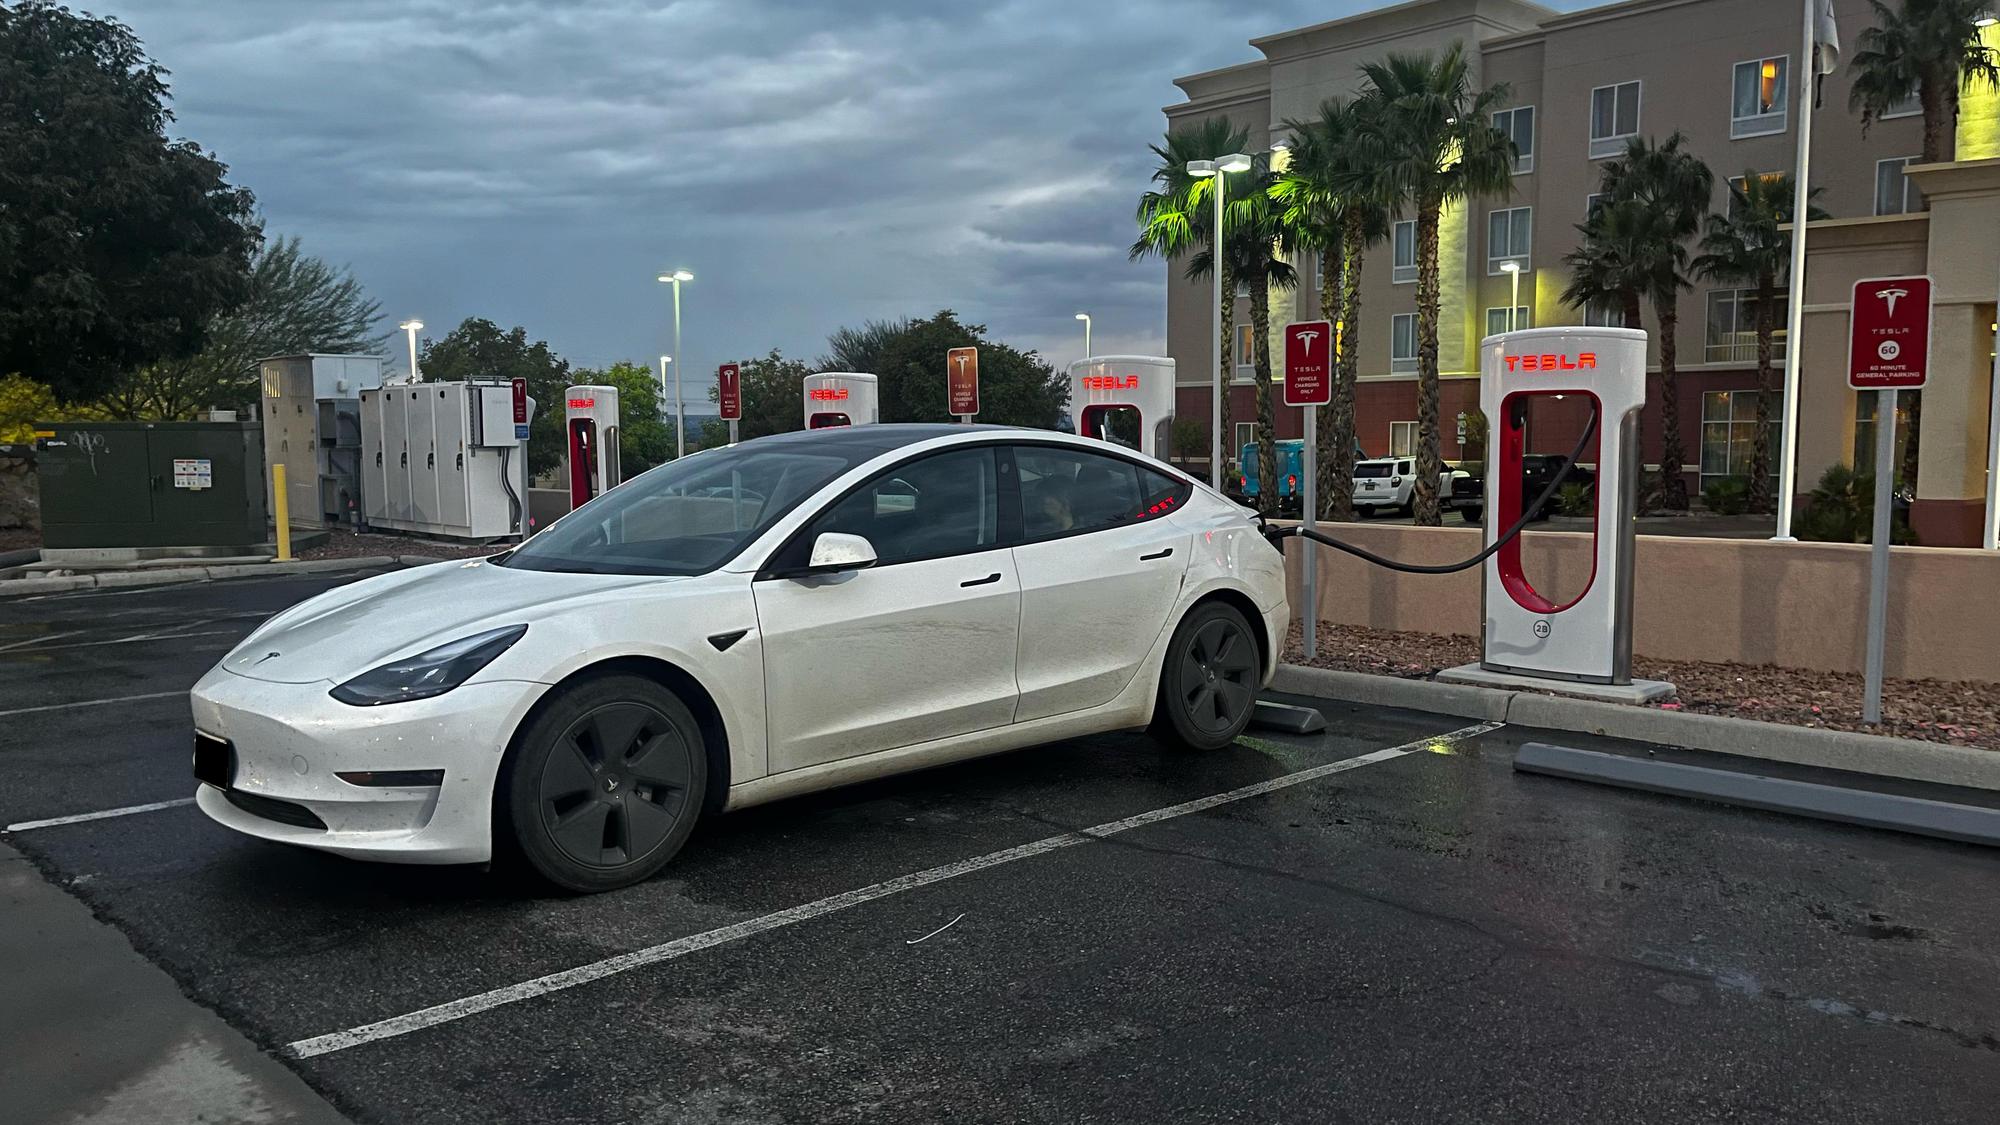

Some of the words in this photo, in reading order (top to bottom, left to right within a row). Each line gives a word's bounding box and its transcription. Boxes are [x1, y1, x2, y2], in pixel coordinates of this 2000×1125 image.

[1872, 327, 1909, 335] TESLA
[1881, 345, 1897, 355] 60
[1505, 353, 1596, 372] TESLA
[1082, 375, 1138, 390] TESLA
[810, 389, 848, 401] TESLA
